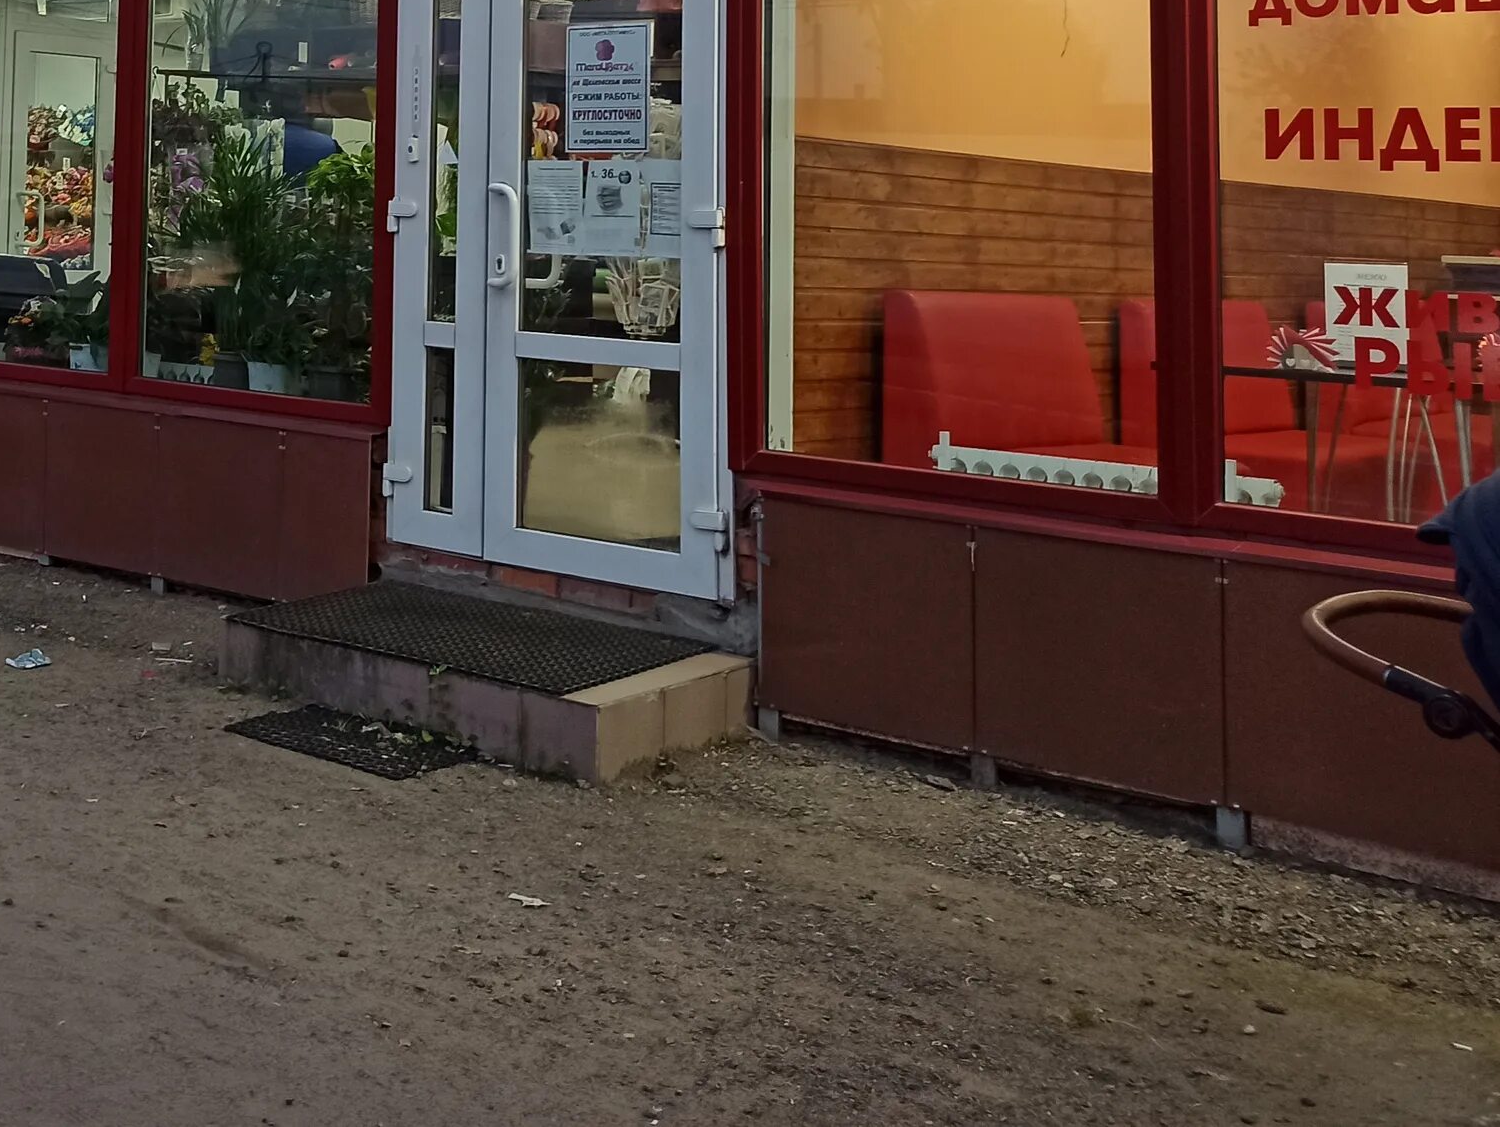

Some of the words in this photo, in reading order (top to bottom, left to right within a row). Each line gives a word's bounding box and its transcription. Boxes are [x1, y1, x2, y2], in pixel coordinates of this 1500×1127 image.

[572, 93, 602, 101] РЕЖИМ
[572, 109, 642, 121] КРУГЛОСУТОЧНО
[1264, 106, 1500, 172] ИНДЕ
